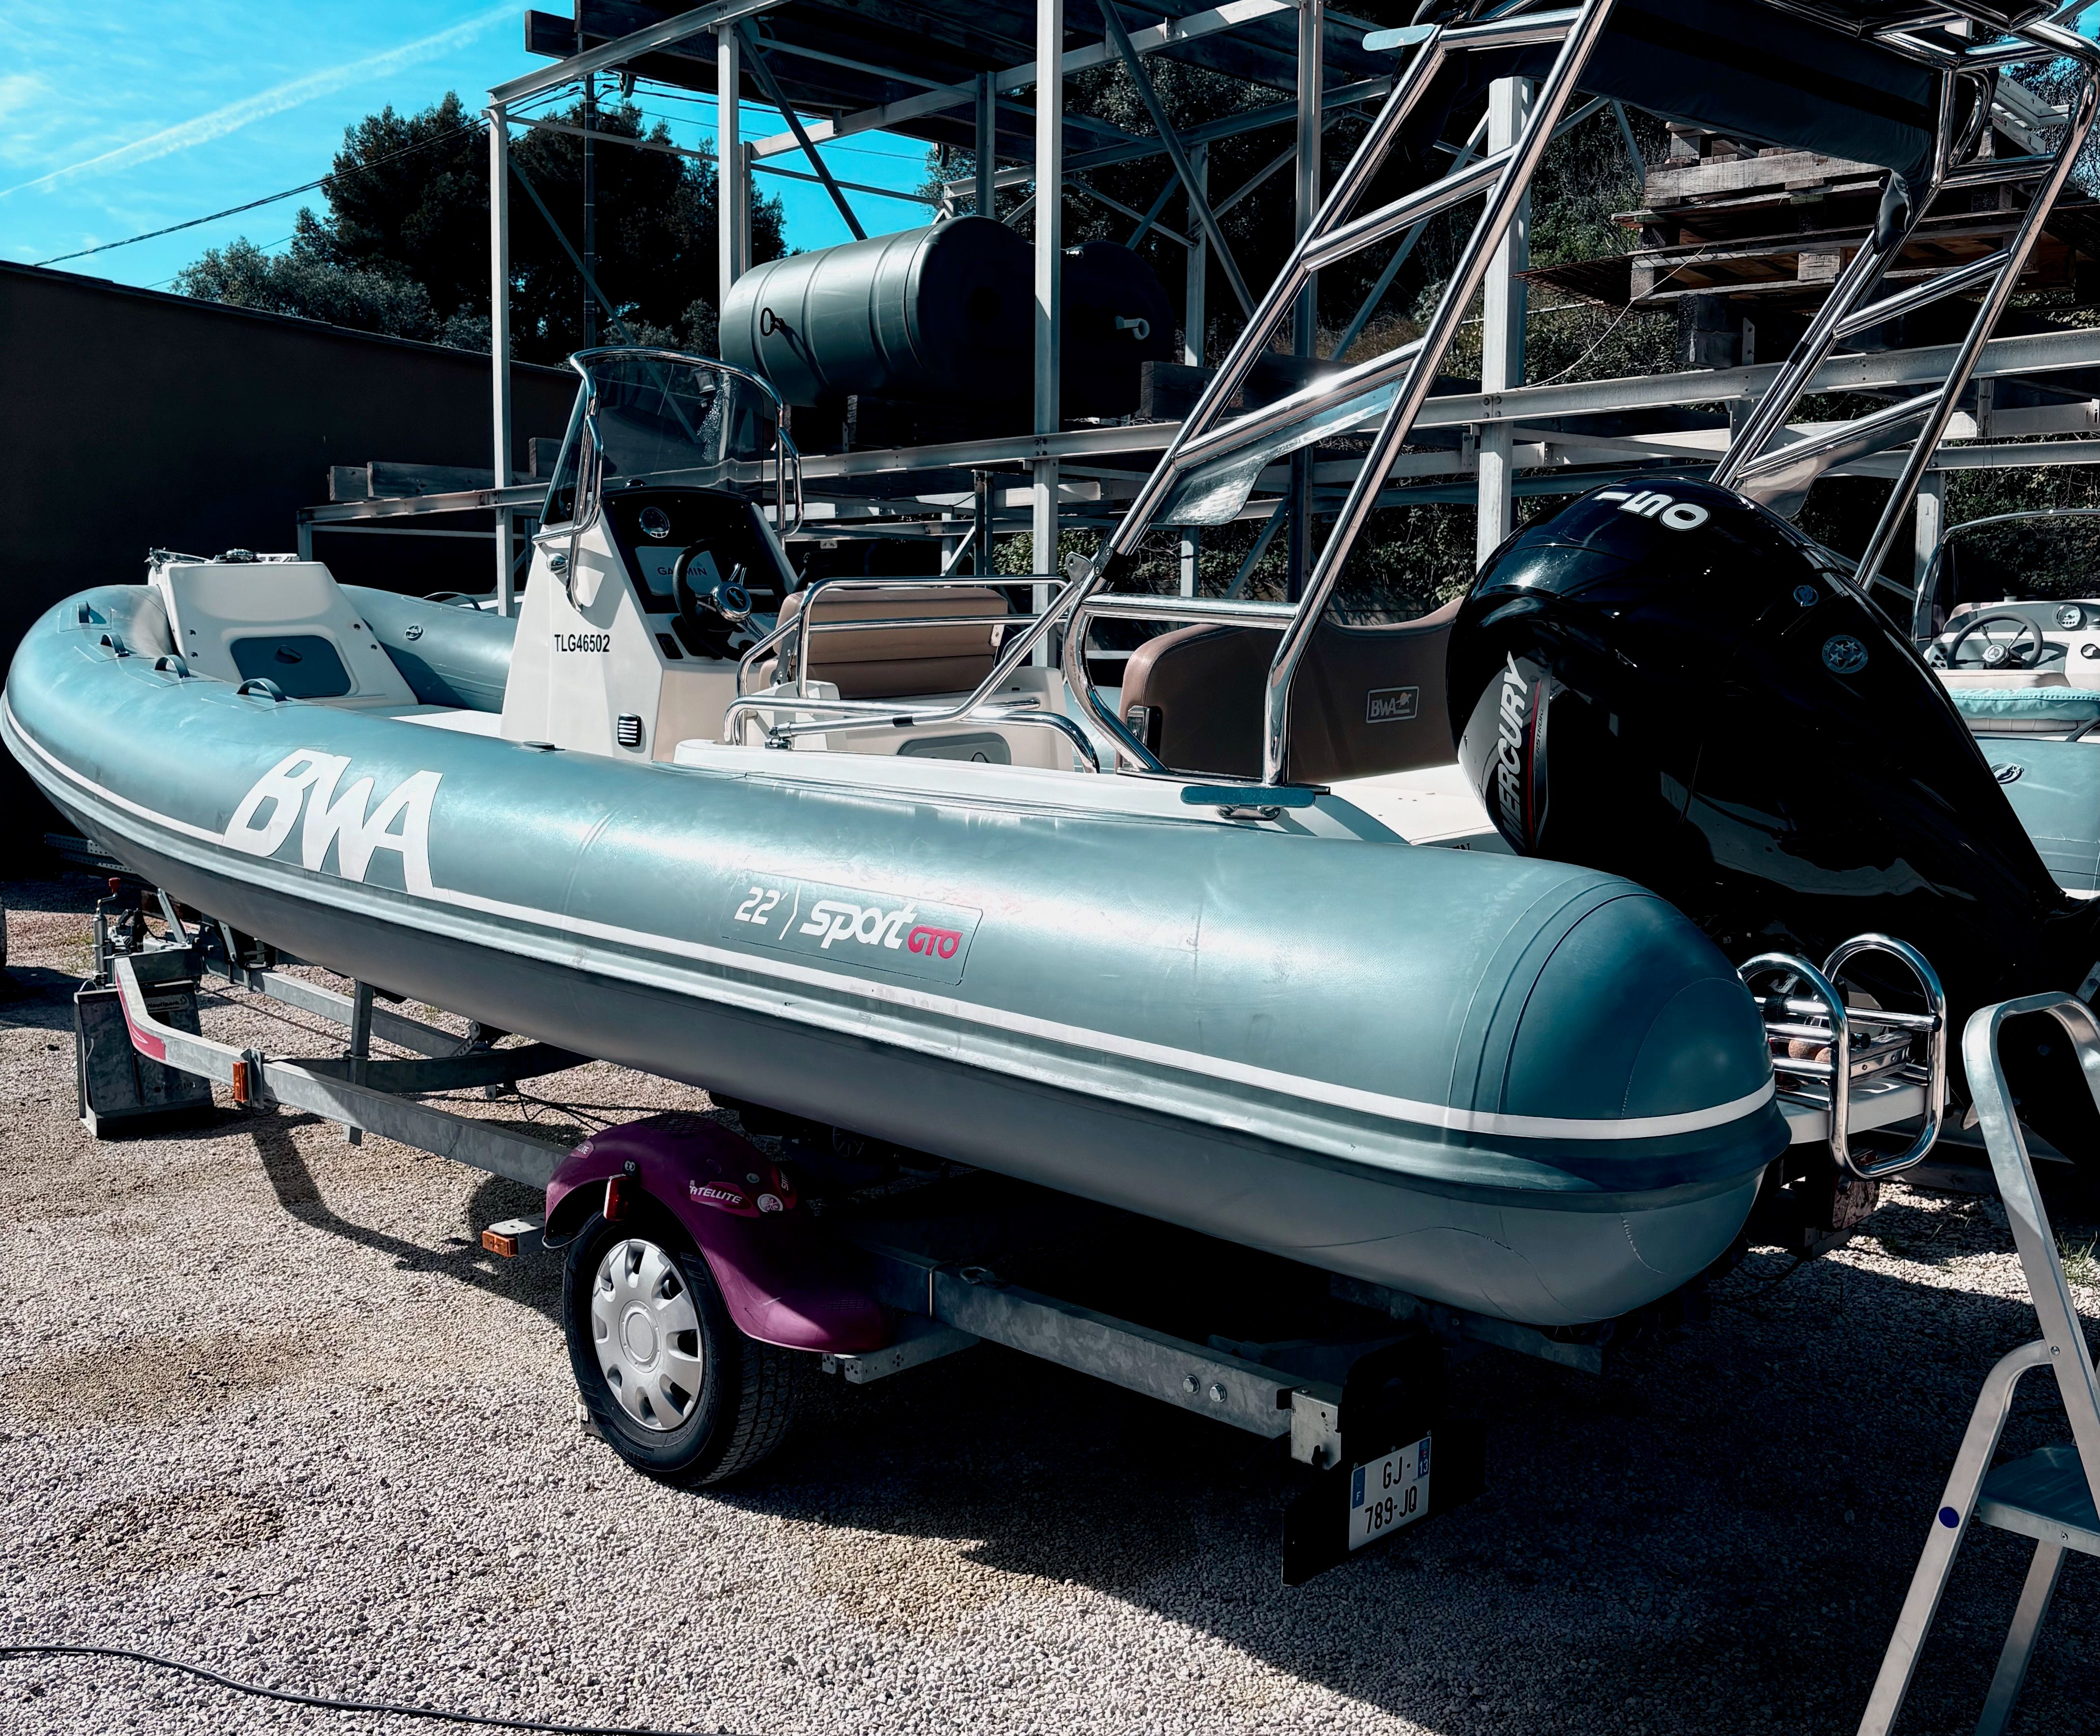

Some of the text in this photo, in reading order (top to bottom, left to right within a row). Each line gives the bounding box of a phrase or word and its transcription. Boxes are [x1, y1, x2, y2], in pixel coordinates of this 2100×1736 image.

[1593, 491, 1710, 530] 150
[658, 567, 707, 576] GAMIN
[554, 634, 611, 652] TLG46502
[1371, 697, 1396, 717] BWA
[1498, 651, 1527, 849] MERCURY
[222, 748, 444, 899] BWA
[907, 924, 963, 959] GTO
[690, 1184, 743, 1204] ATELLITE
[1419, 1458, 1428, 1474] 13
[1356, 1491, 1361, 1500] F
[1365, 1485, 1417, 1534] 789-JQ
